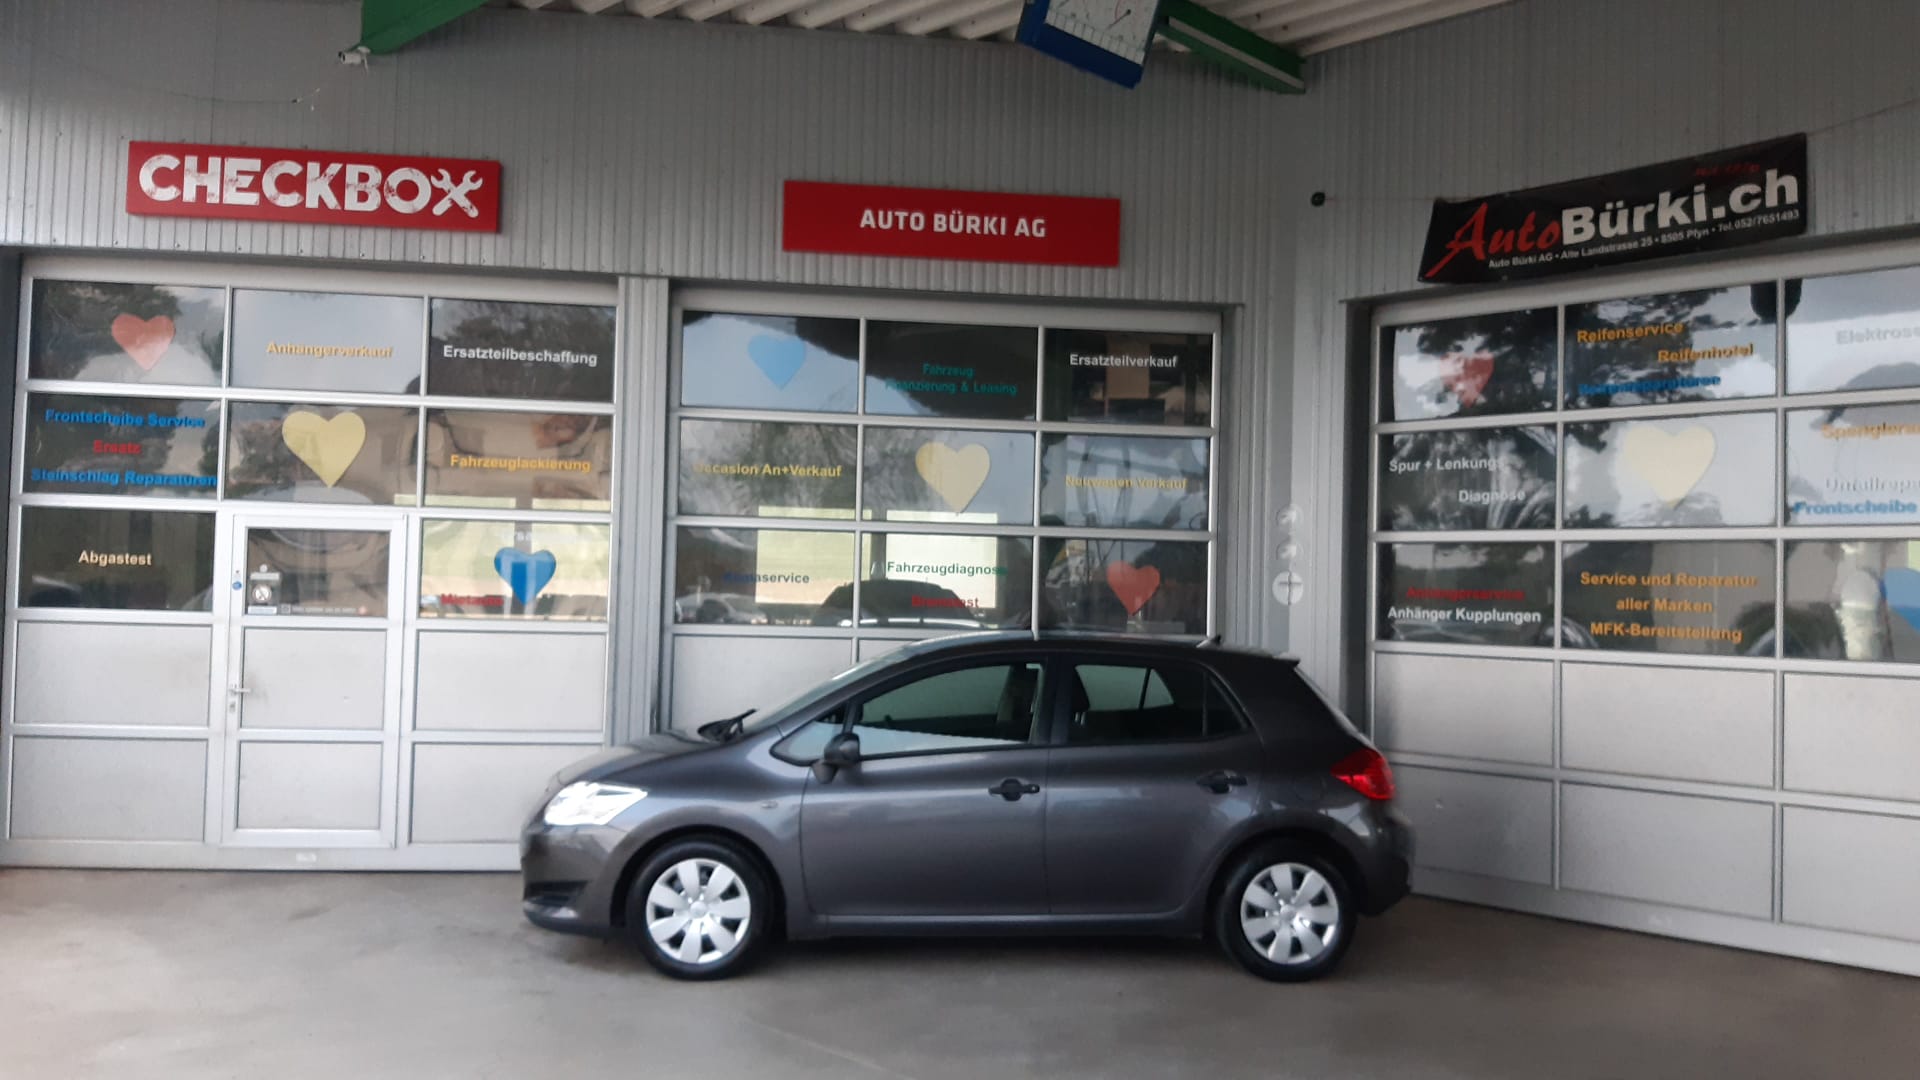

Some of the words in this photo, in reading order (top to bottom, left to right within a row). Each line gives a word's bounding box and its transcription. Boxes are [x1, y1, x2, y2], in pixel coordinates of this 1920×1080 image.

[139, 153, 484, 219] CHECKBOX
[860, 207, 926, 233] AUTO
[932, 208, 1007, 237] BÜRKI
[1014, 216, 1047, 239] AG
[1488, 257, 1511, 269] Auto
[1538, 251, 1554, 263] AG
[1577, 322, 1684, 344] Reifenservice
[443, 344, 598, 368] Ersatzteilbeschaffung
[1069, 354, 1178, 370] Ersatzteilverkauf
[922, 362, 975, 379] Fahrzeug
[45, 408, 144, 427] Frontscheibe
[147, 412, 206, 428] Service
[450, 454, 592, 474] Fahrzeuglackierung
[1389, 459, 1420, 474] Spur
[31, 468, 120, 486] Steinschlag
[1793, 499, 1918, 515] Frontscheibe
[78, 550, 151, 567] Abgastest
[1580, 571, 1637, 586] Service
[1641, 572, 1672, 586] und
[1676, 573, 1758, 590] Reparatur
[1616, 597, 1650, 612] aller
[1654, 598, 1713, 613] Marken
[1388, 606, 1453, 623] Anhänger
[1455, 607, 1542, 625] Kupplungen
